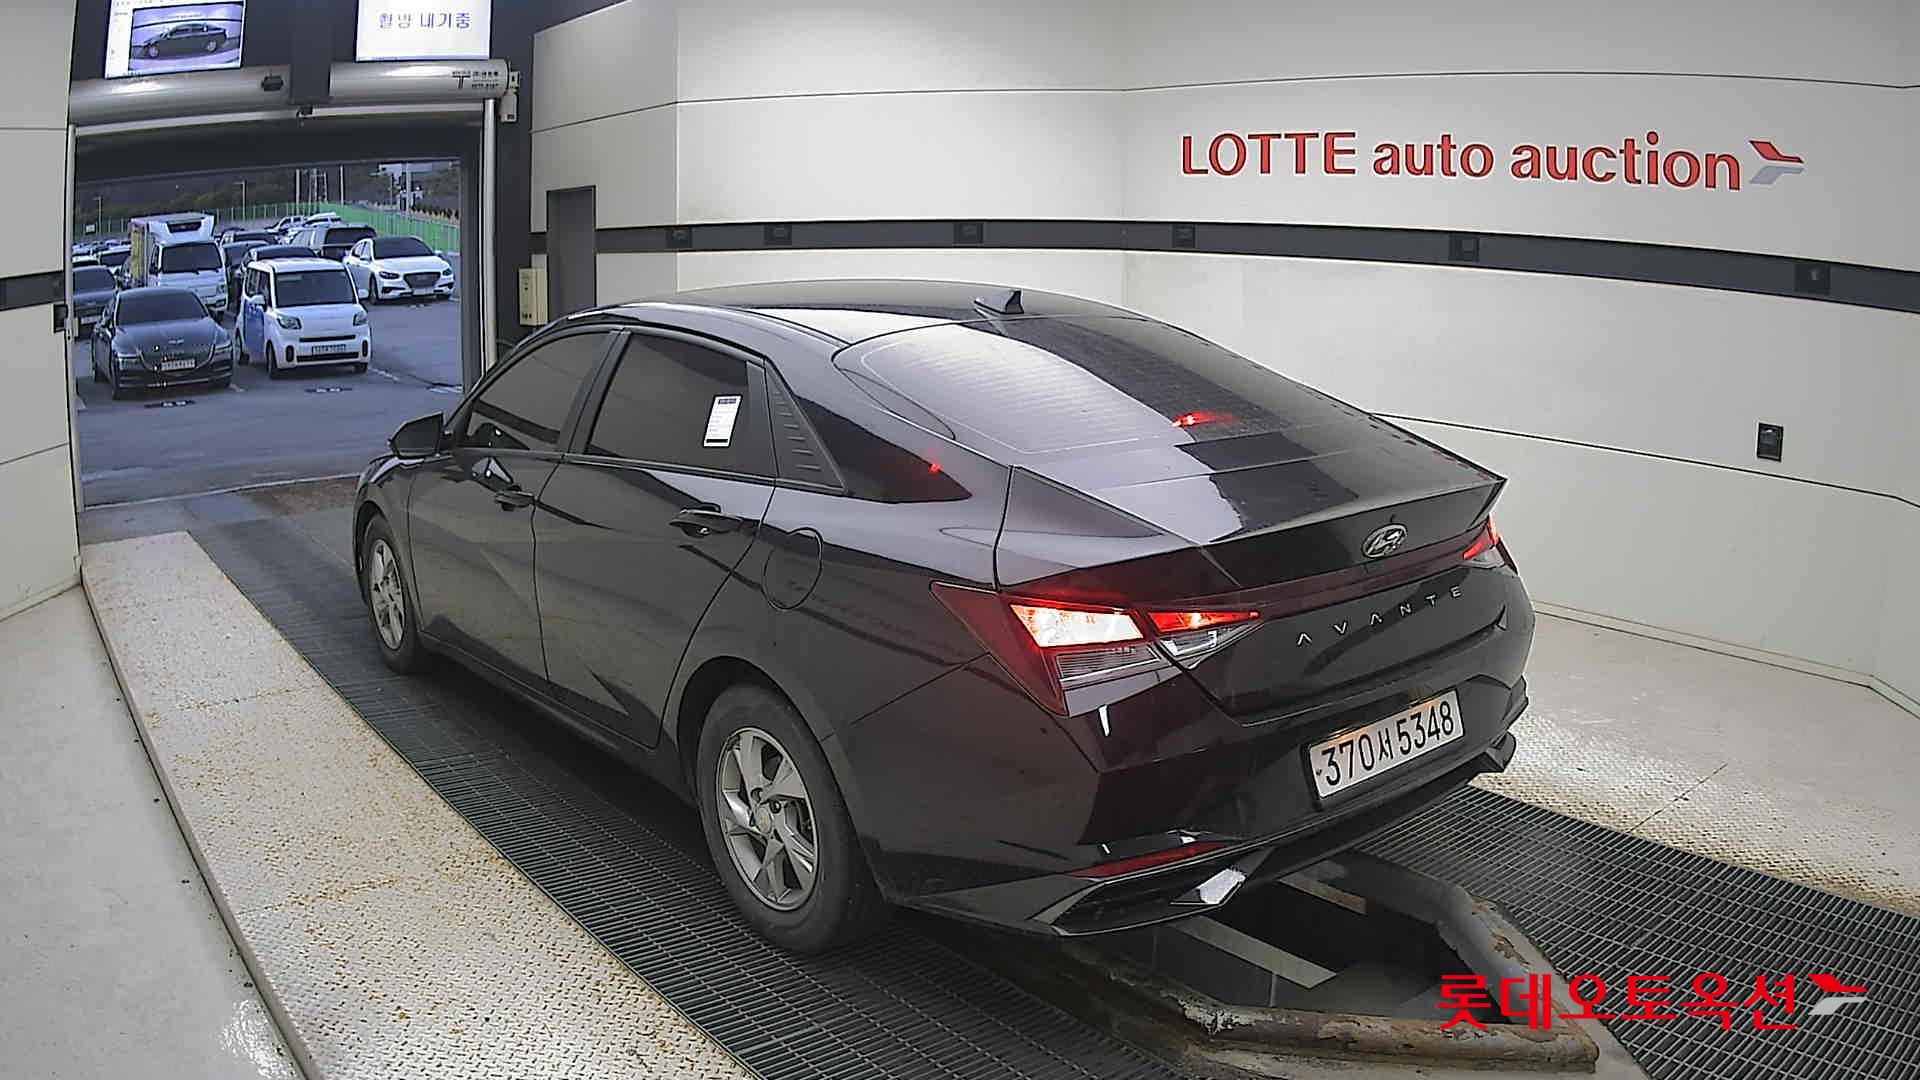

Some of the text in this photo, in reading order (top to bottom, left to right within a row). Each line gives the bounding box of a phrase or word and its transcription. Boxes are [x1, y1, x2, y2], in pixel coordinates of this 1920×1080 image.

[1182, 131, 1741, 191] LOTTE auto auction
[1297, 586, 1462, 646] AVANTE
